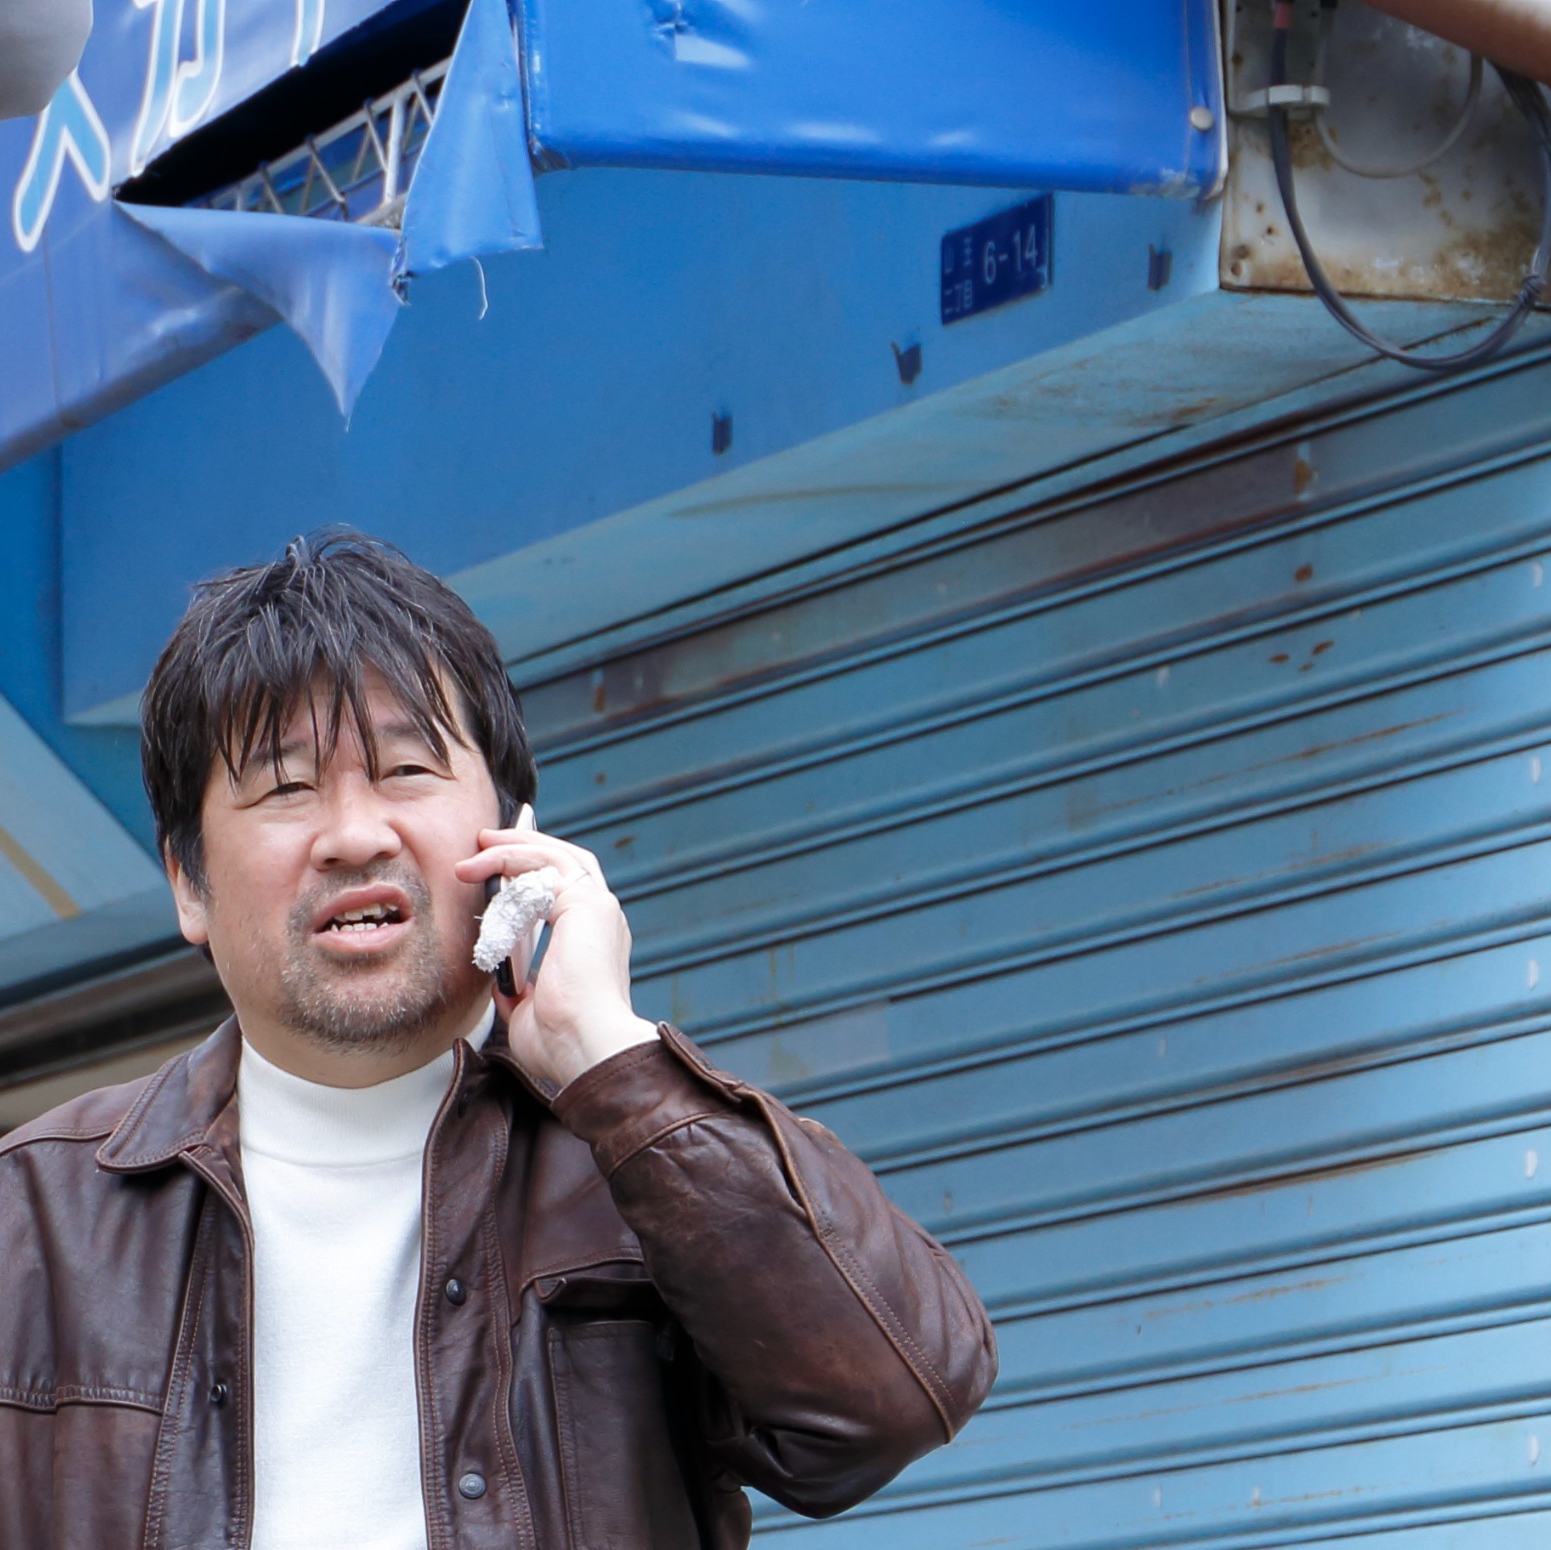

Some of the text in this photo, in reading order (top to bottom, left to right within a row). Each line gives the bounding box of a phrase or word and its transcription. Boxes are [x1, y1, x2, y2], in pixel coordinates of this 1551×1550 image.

[983, 223, 1039, 285] 6-14
[944, 279, 973, 315] 二丁目
